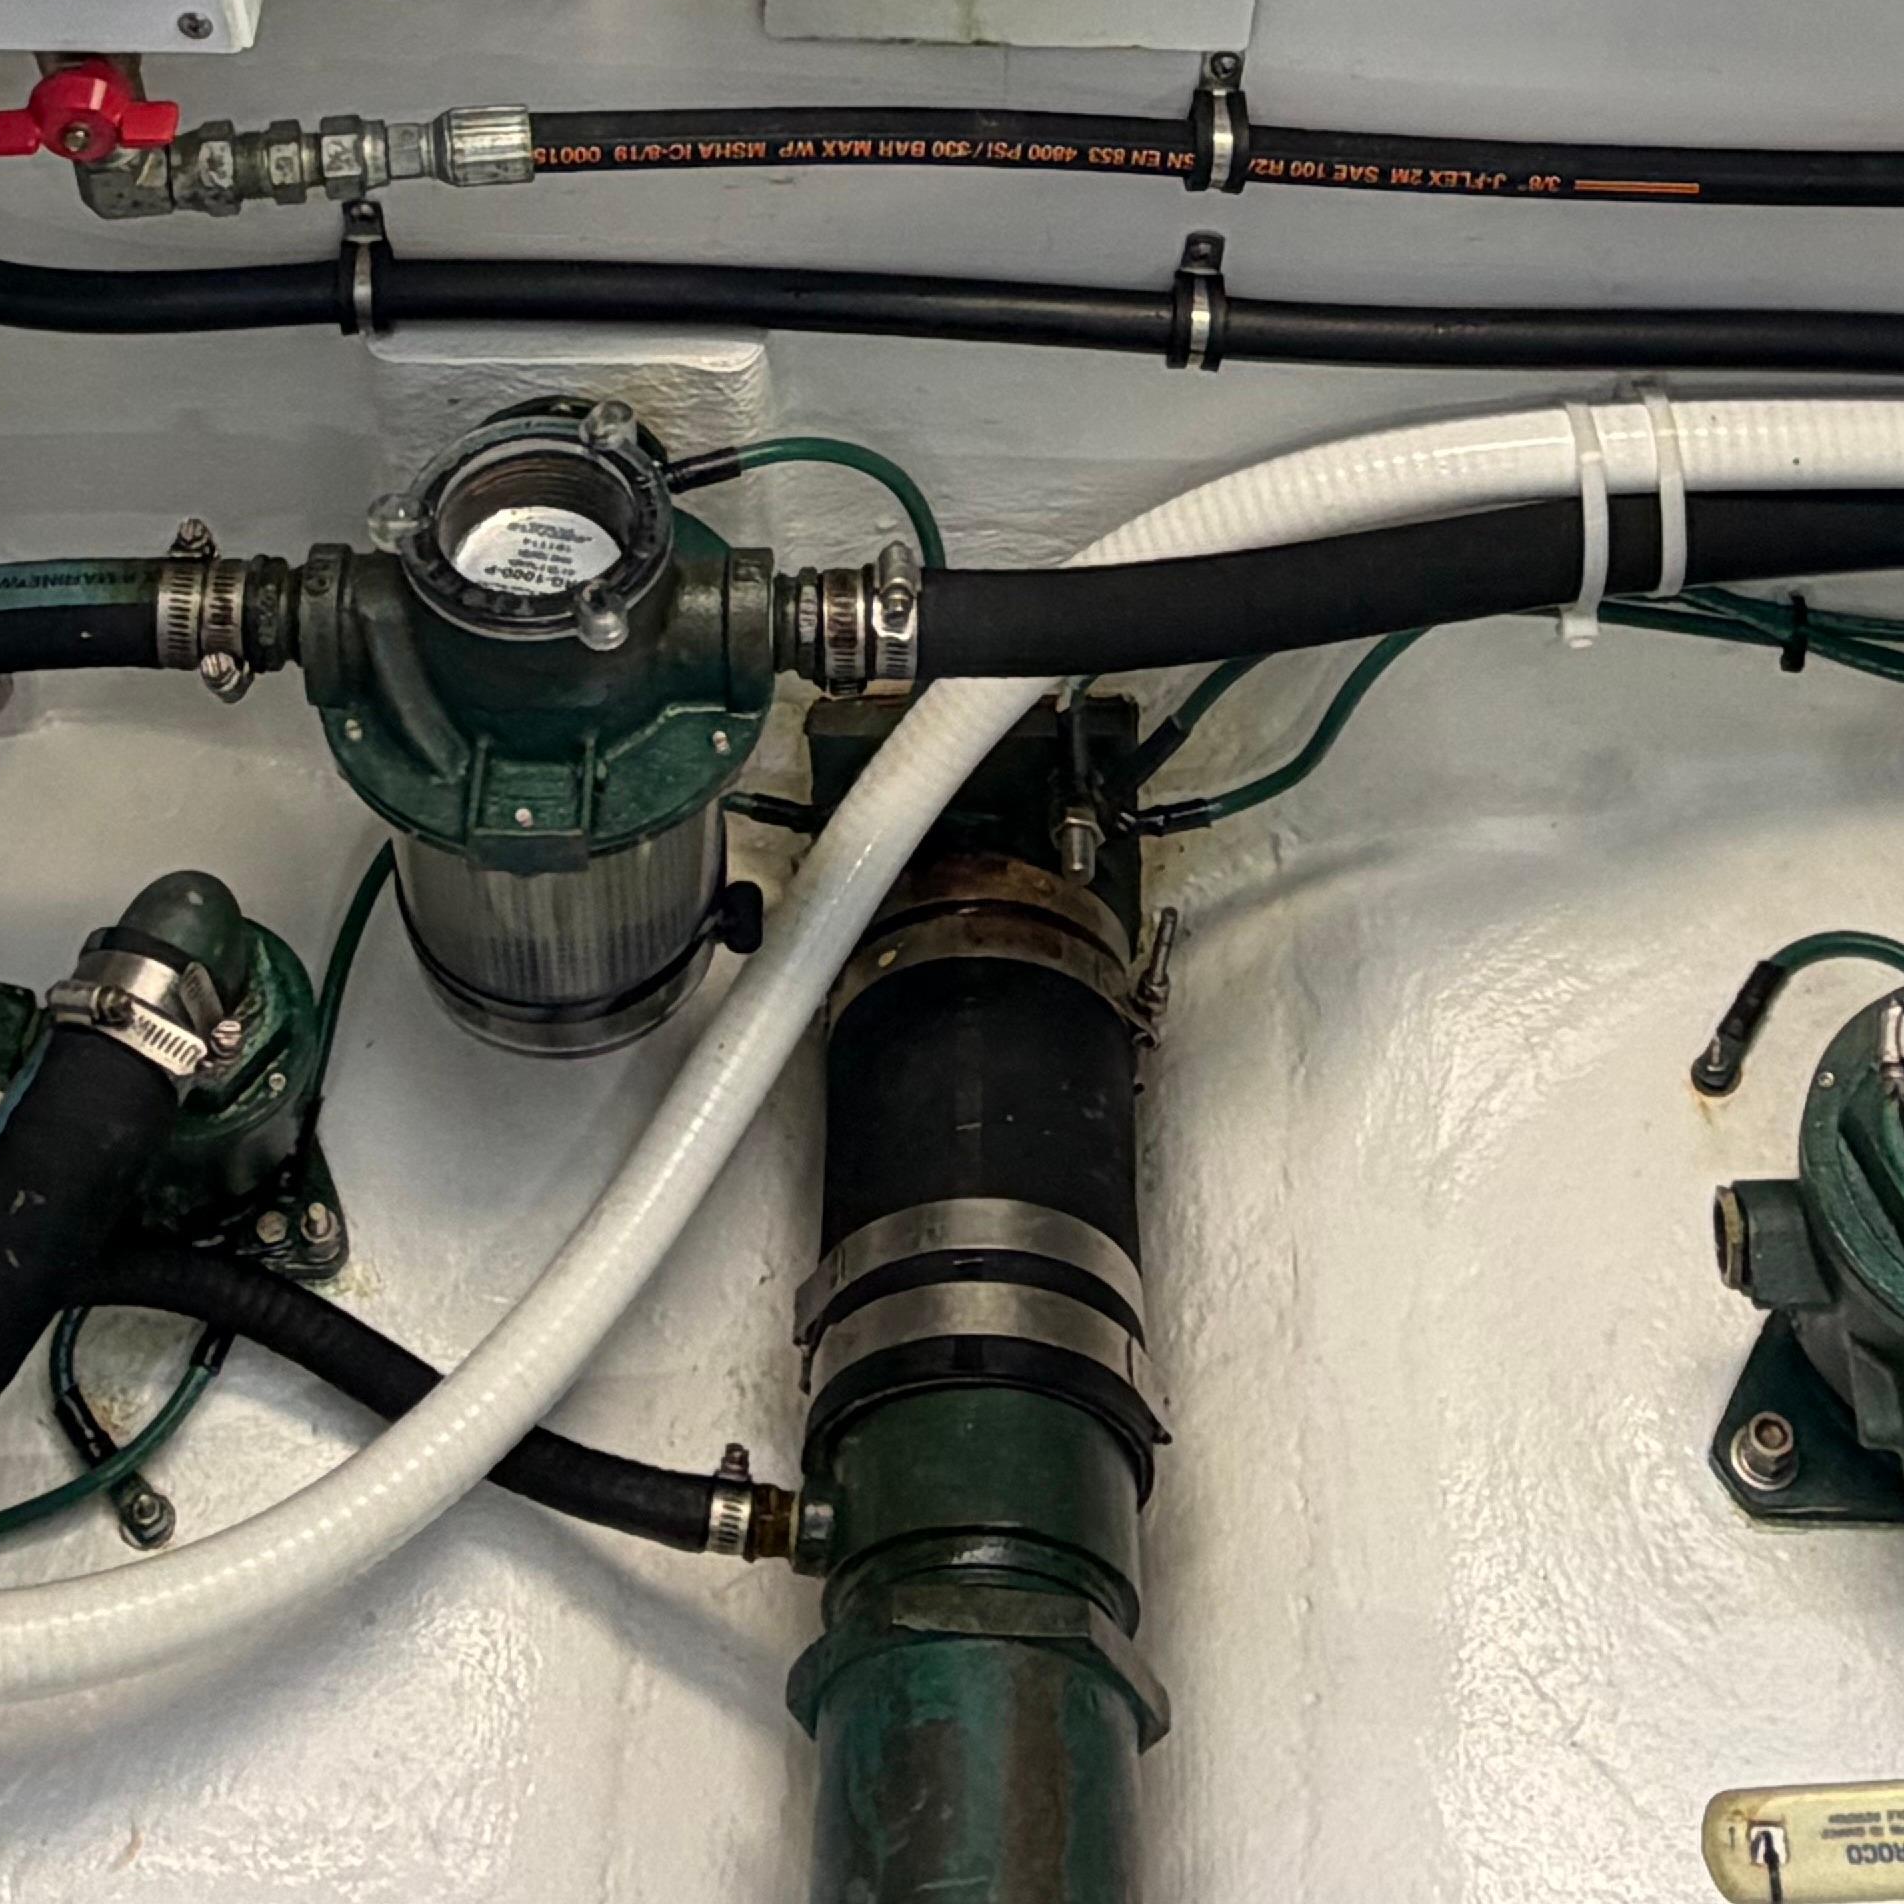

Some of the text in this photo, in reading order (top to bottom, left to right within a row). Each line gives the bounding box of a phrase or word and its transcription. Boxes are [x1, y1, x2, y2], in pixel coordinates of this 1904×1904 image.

[698, 142, 766, 160] MSHA
[781, 141, 817, 157] WP
[823, 140, 873, 157] MAX
[878, 140, 926, 157] BAR
[1028, 145, 1078, 161] 4800
[1087, 147, 1126, 164] 853
[1131, 149, 1162, 165] EN
[1290, 162, 1326, 178] 100
[1334, 165, 1379, 182] SAE
[1389, 168, 1423, 184] 2M
